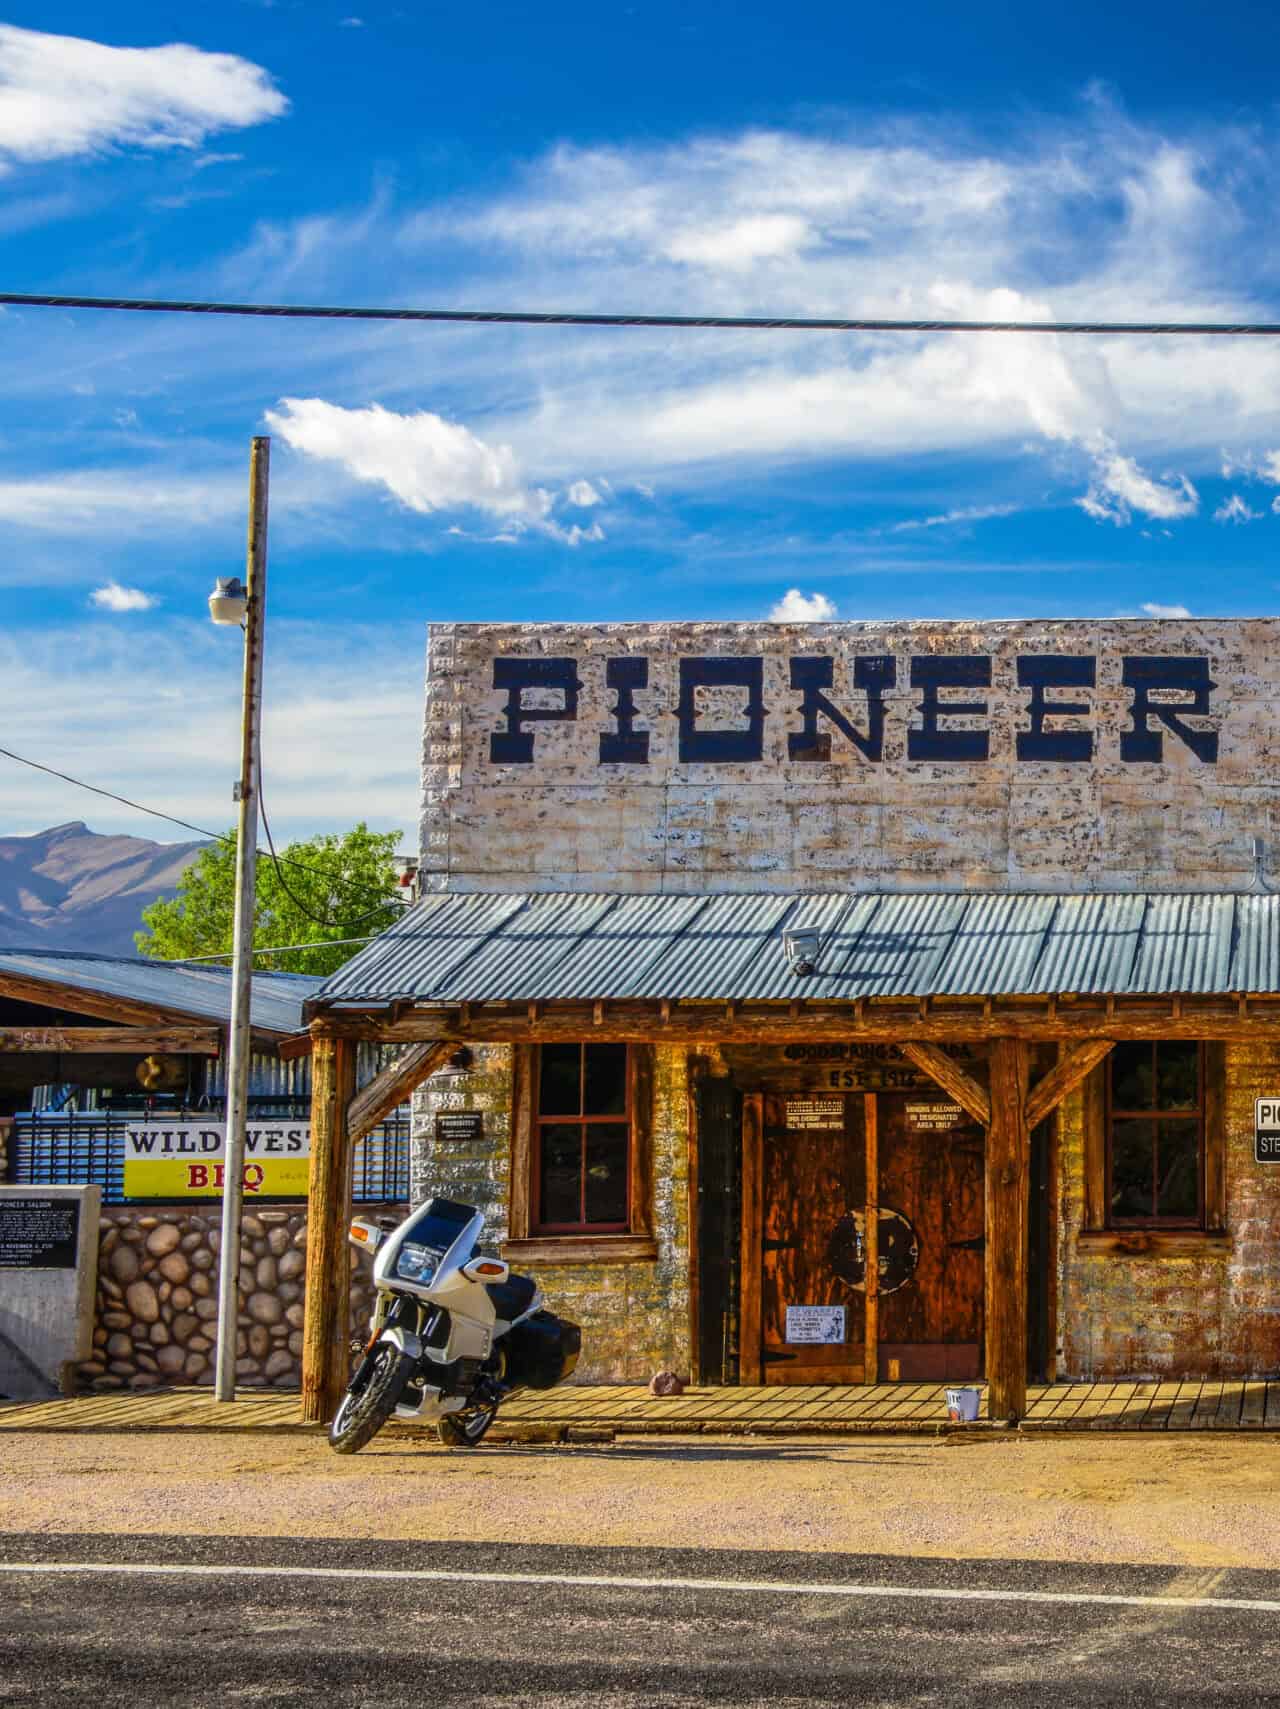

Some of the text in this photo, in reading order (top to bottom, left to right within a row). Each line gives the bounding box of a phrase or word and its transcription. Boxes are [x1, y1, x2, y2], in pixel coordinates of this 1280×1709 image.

[490, 655, 1219, 764] PIONEER
[932, 1105, 962, 1113] ALLOWED
[917, 1121, 934, 1129] AREA
[129, 1130, 312, 1152] WILD ES
